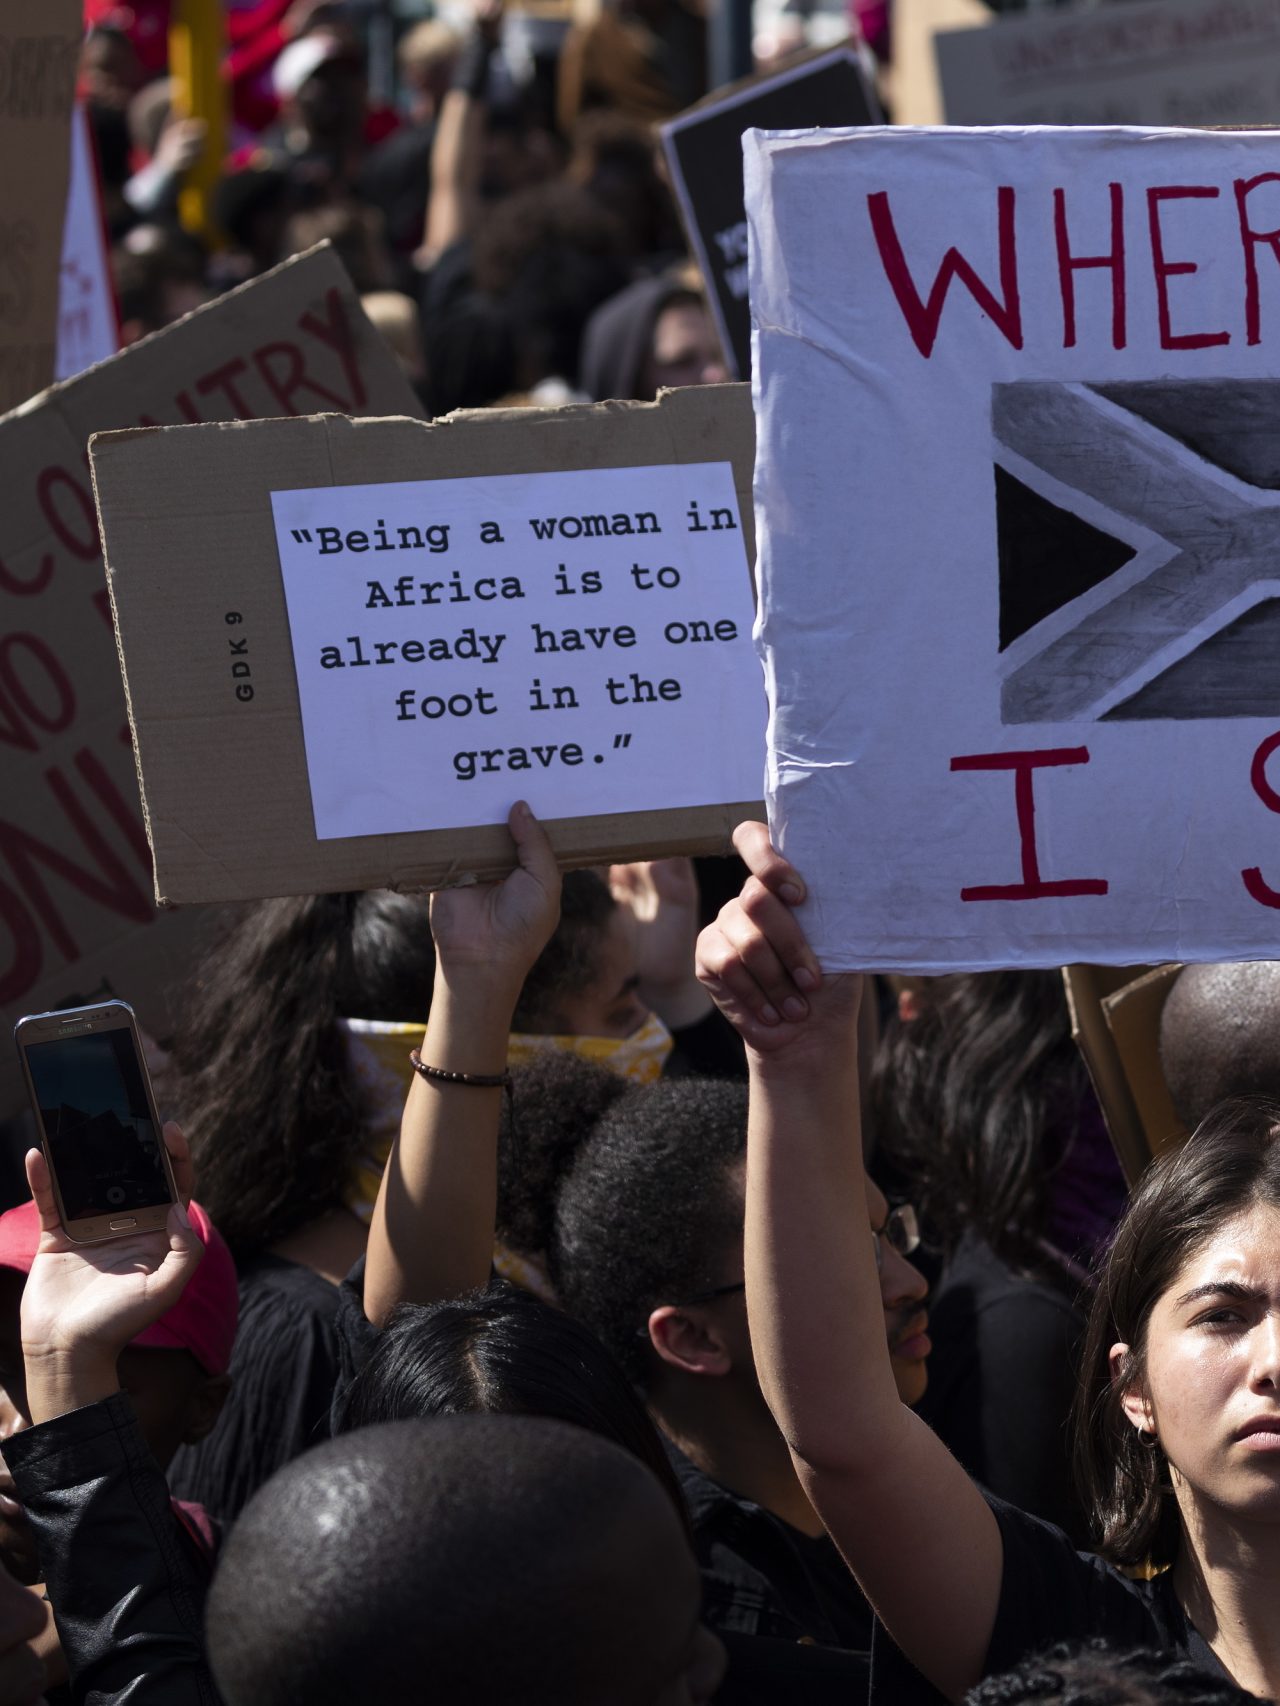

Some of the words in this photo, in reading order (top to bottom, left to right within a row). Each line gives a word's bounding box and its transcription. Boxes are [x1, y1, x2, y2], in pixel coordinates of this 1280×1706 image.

[480, 521, 505, 544] a
[529, 511, 662, 540] woman
[688, 501, 738, 532] in
[365, 572, 526, 609] Africa
[555, 563, 603, 595] is
[630, 561, 681, 590] to
[320, 628, 506, 669] already
[532, 621, 638, 653] have
[663, 618, 738, 644] one
[228, 637, 255, 702] GDK
[395, 688, 498, 721] foot
[529, 679, 580, 711] in
[605, 673, 683, 705] the
[950, 746, 1109, 902] I
